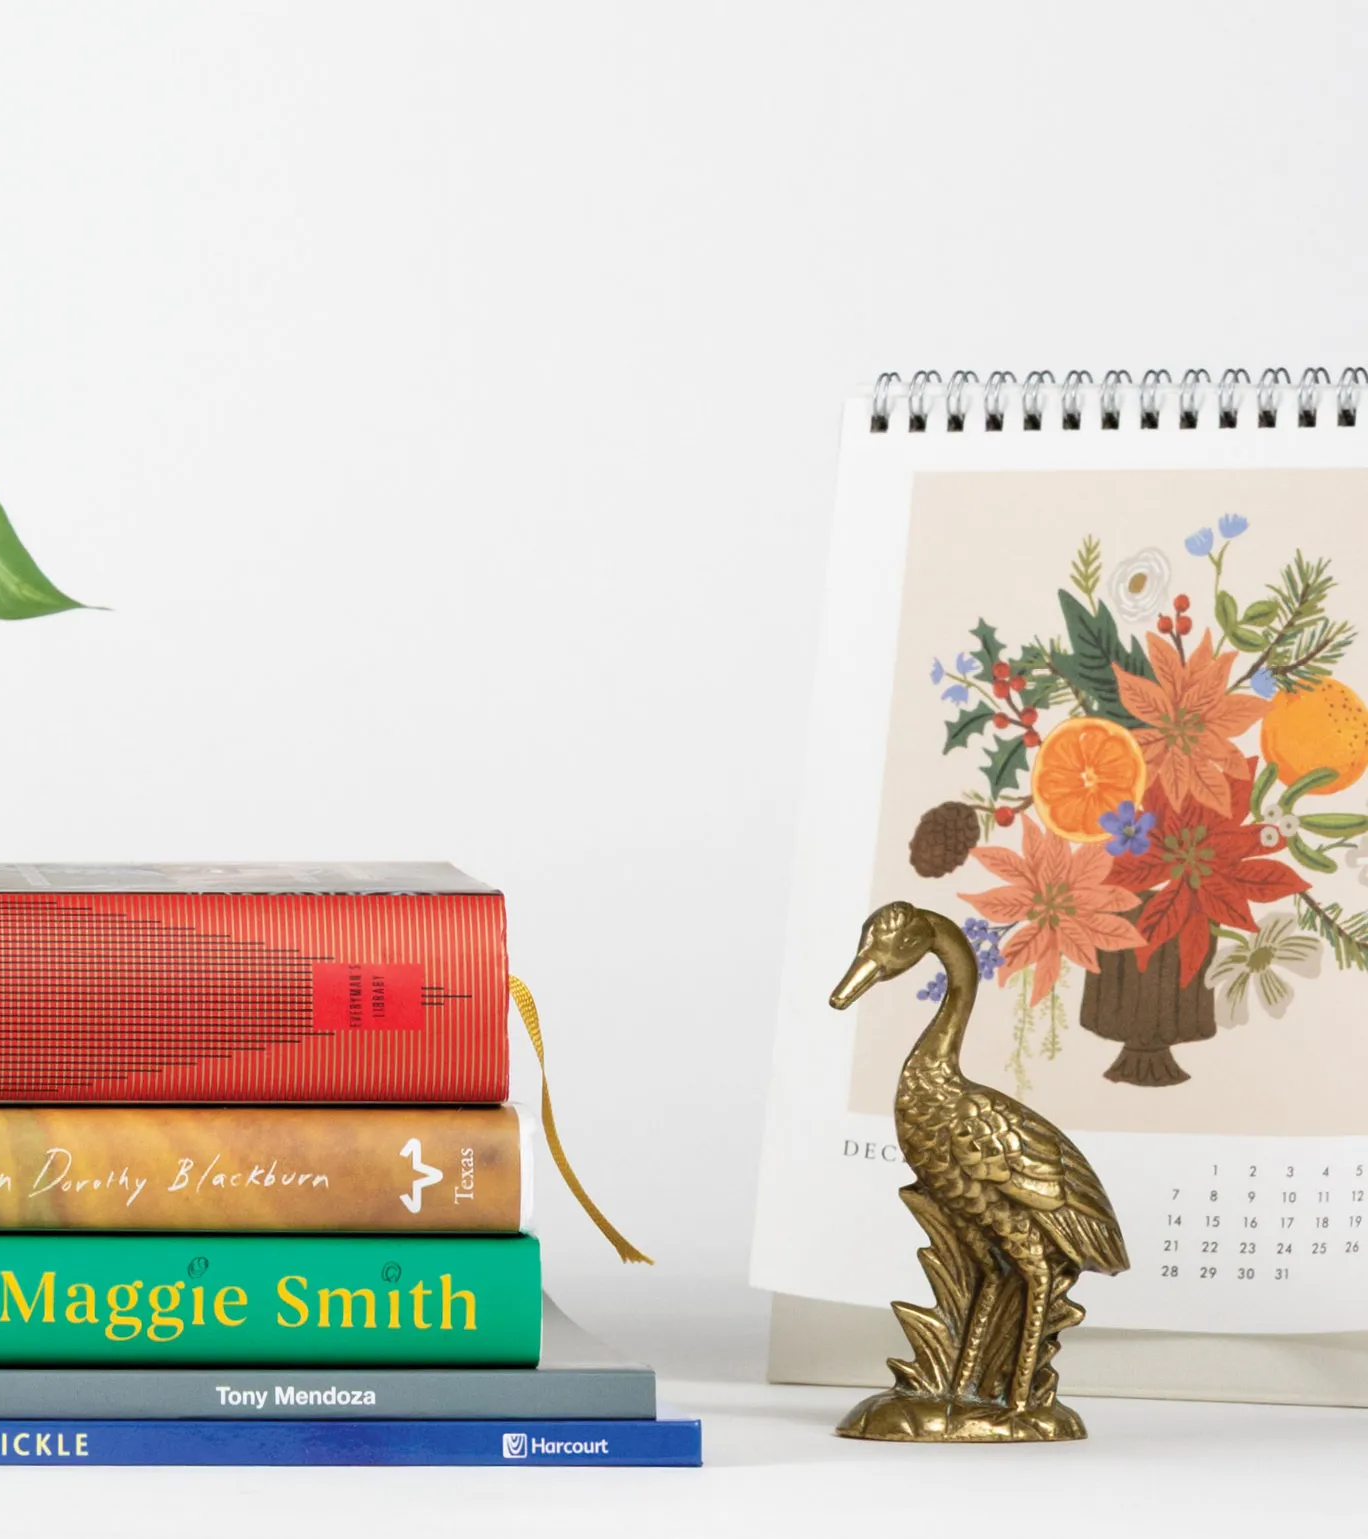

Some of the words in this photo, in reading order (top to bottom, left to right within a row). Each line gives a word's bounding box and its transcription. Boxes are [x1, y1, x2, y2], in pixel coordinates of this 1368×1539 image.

[372, 975, 385, 1019] LIBRARY
[29, 1147, 148, 1206] Dorothy
[167, 1153, 330, 1193] Blackburn
[454, 1147, 475, 1204] Texas
[1212, 1164, 1218, 1176] 1
[1249, 1165, 1257, 1178] 2
[1286, 1166, 1295, 1178] 3
[1321, 1166, 1330, 1177] 4
[1355, 1164, 1364, 1177] 5
[1172, 1188, 1180, 1201] 7
[1209, 1190, 1218, 1202] 8
[1247, 1191, 1256, 1203] 9
[1282, 1191, 1297, 1203] 10
[1318, 1191, 1330, 1203] 11
[1351, 1190, 1364, 1202] 12
[1167, 1214, 1182, 1227] 14
[1205, 1215, 1221, 1228] 15
[1243, 1216, 1258, 1229] 16
[1281, 1217, 1295, 1229] 17
[1316, 1216, 1330, 1229] 18
[1349, 1215, 1363, 1228] 19
[1164, 1239, 1179, 1252] 21
[1201, 1241, 1219, 1253] 22
[1239, 1242, 1256, 1254] 23
[1276, 1243, 1293, 1254] 24
[1312, 1242, 1327, 1255] 25
[1345, 1240, 1360, 1253] 26
[1161, 1265, 1179, 1278] 28
[1199, 1266, 1217, 1279] 29
[1237, 1267, 1255, 1280] 30
[1274, 1268, 1289, 1280] 31
[0, 1270, 248, 1342] Maggie
[276, 1274, 478, 1331] Smith
[215, 1386, 268, 1410] Tony
[274, 1386, 376, 1406] Mendoza
[531, 1437, 609, 1454] Harcourt
